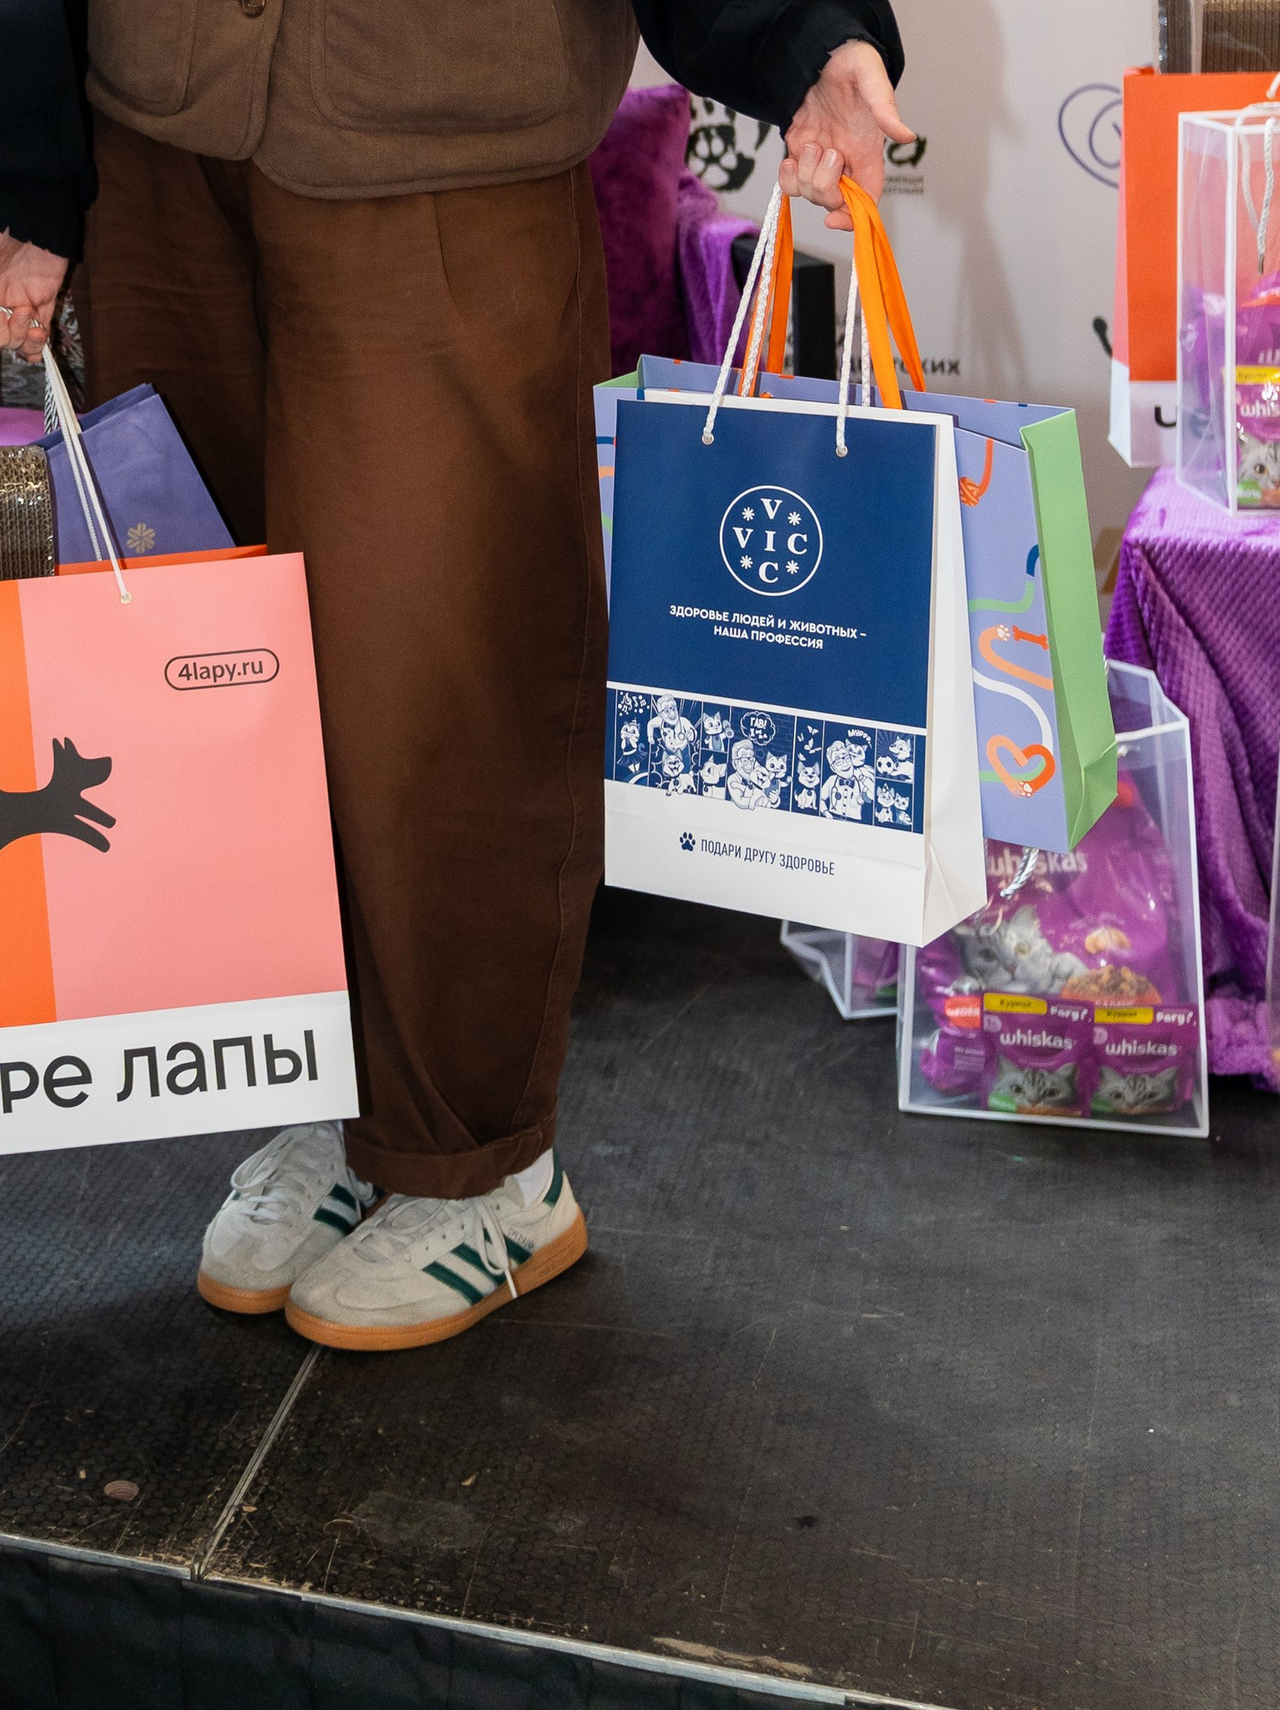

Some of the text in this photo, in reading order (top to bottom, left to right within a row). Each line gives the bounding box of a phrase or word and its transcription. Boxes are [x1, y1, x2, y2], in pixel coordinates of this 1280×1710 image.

[669, 605, 729, 622] ЗДОРОВЬЕ
[731, 613, 775, 628] ЛЮДЕЙ
[777, 619, 787, 629] И
[789, 620, 858, 639] ЖИВОТНЫХ
[714, 626, 824, 650] НАША ПРОФЕССИЯ
[178, 657, 264, 685] 4lapy.ru
[701, 839, 835, 875] ПОДАРИ ДРУГУ ЗДОРОВЬЕ
[1000, 1028, 1073, 1050] whiskas
[1105, 1038, 1178, 1057] whiskas
[116, 1028, 319, 1103] лапы
